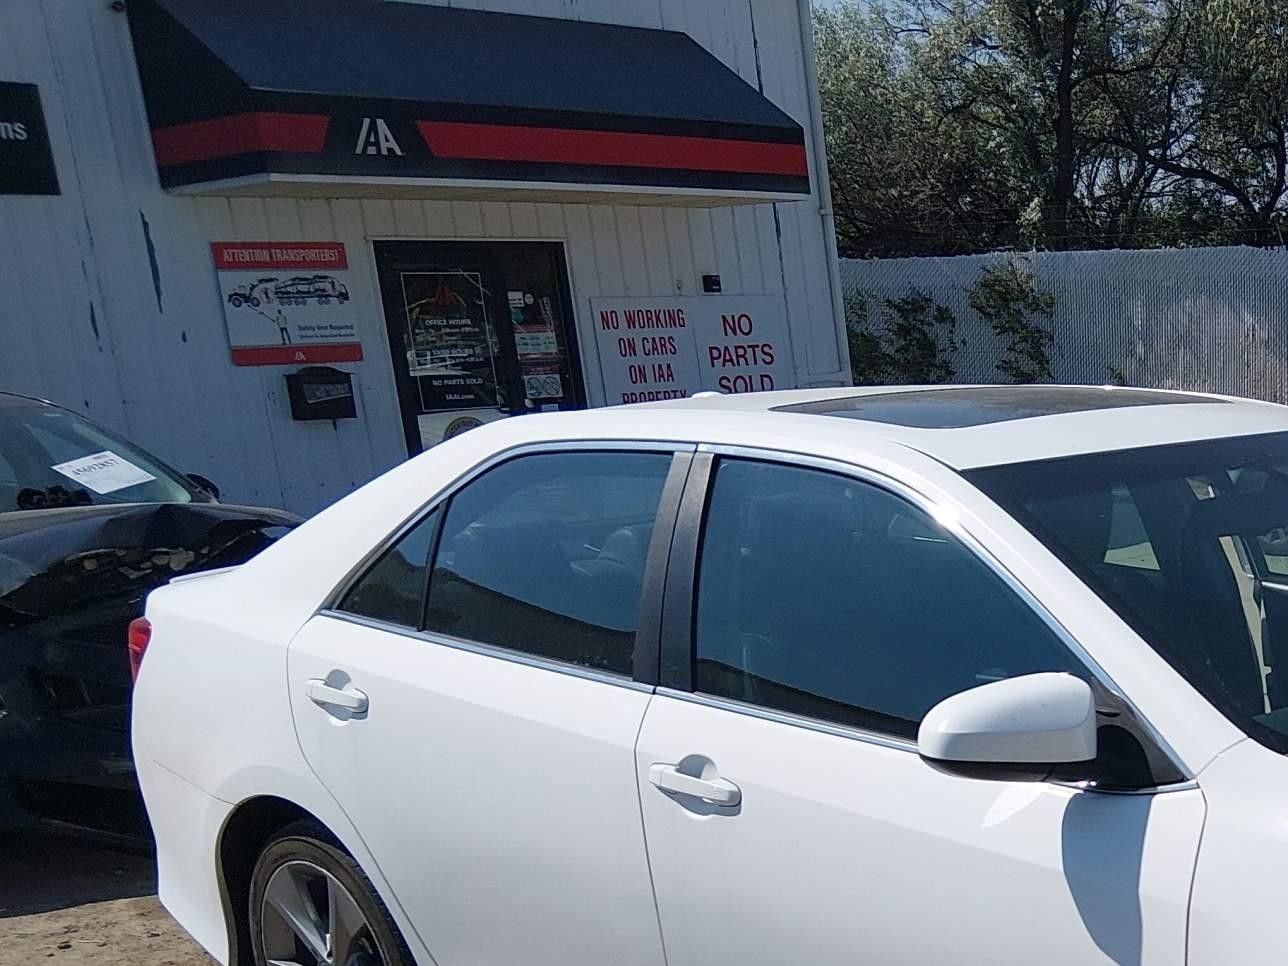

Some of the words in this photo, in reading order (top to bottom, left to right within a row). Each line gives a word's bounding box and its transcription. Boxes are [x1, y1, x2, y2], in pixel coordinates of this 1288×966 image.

[223, 249, 270, 262] ATTENTION
[271, 249, 338, 261] TRANSPORTERS!
[600, 310, 620, 330] NO
[624, 309, 686, 330] WORKING
[721, 314, 752, 337] NO
[618, 337, 637, 358] ON
[641, 336, 677, 356] CARS
[708, 343, 775, 368] PARTS
[629, 364, 648, 385] ON
[652, 363, 675, 383] IAA
[718, 374, 774, 394] SOLD
